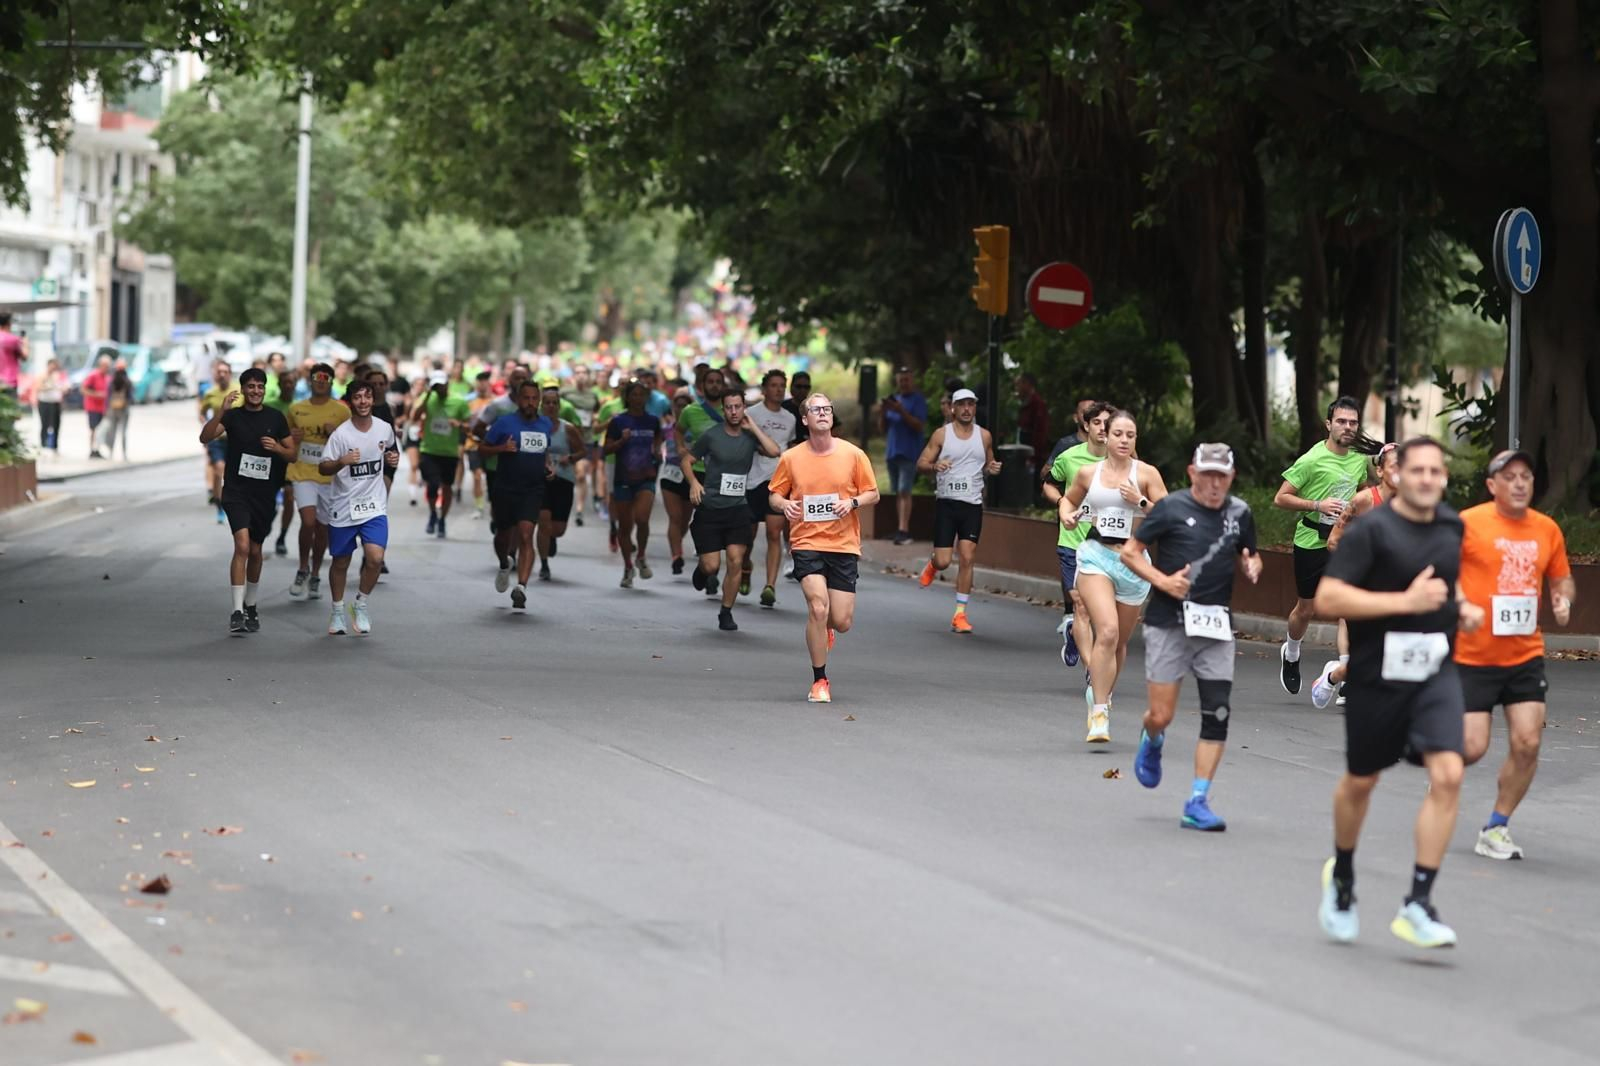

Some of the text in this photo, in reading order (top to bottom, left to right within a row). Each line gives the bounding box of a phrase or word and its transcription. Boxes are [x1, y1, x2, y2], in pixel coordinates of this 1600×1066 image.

[244, 462, 267, 471] 1139
[352, 465, 368, 475] TM
[354, 502, 375, 512] 454
[808, 503, 833, 513] 826
[1100, 517, 1125, 528] 325
[1501, 610, 1531, 622] 817
[1192, 615, 1222, 628] 279
